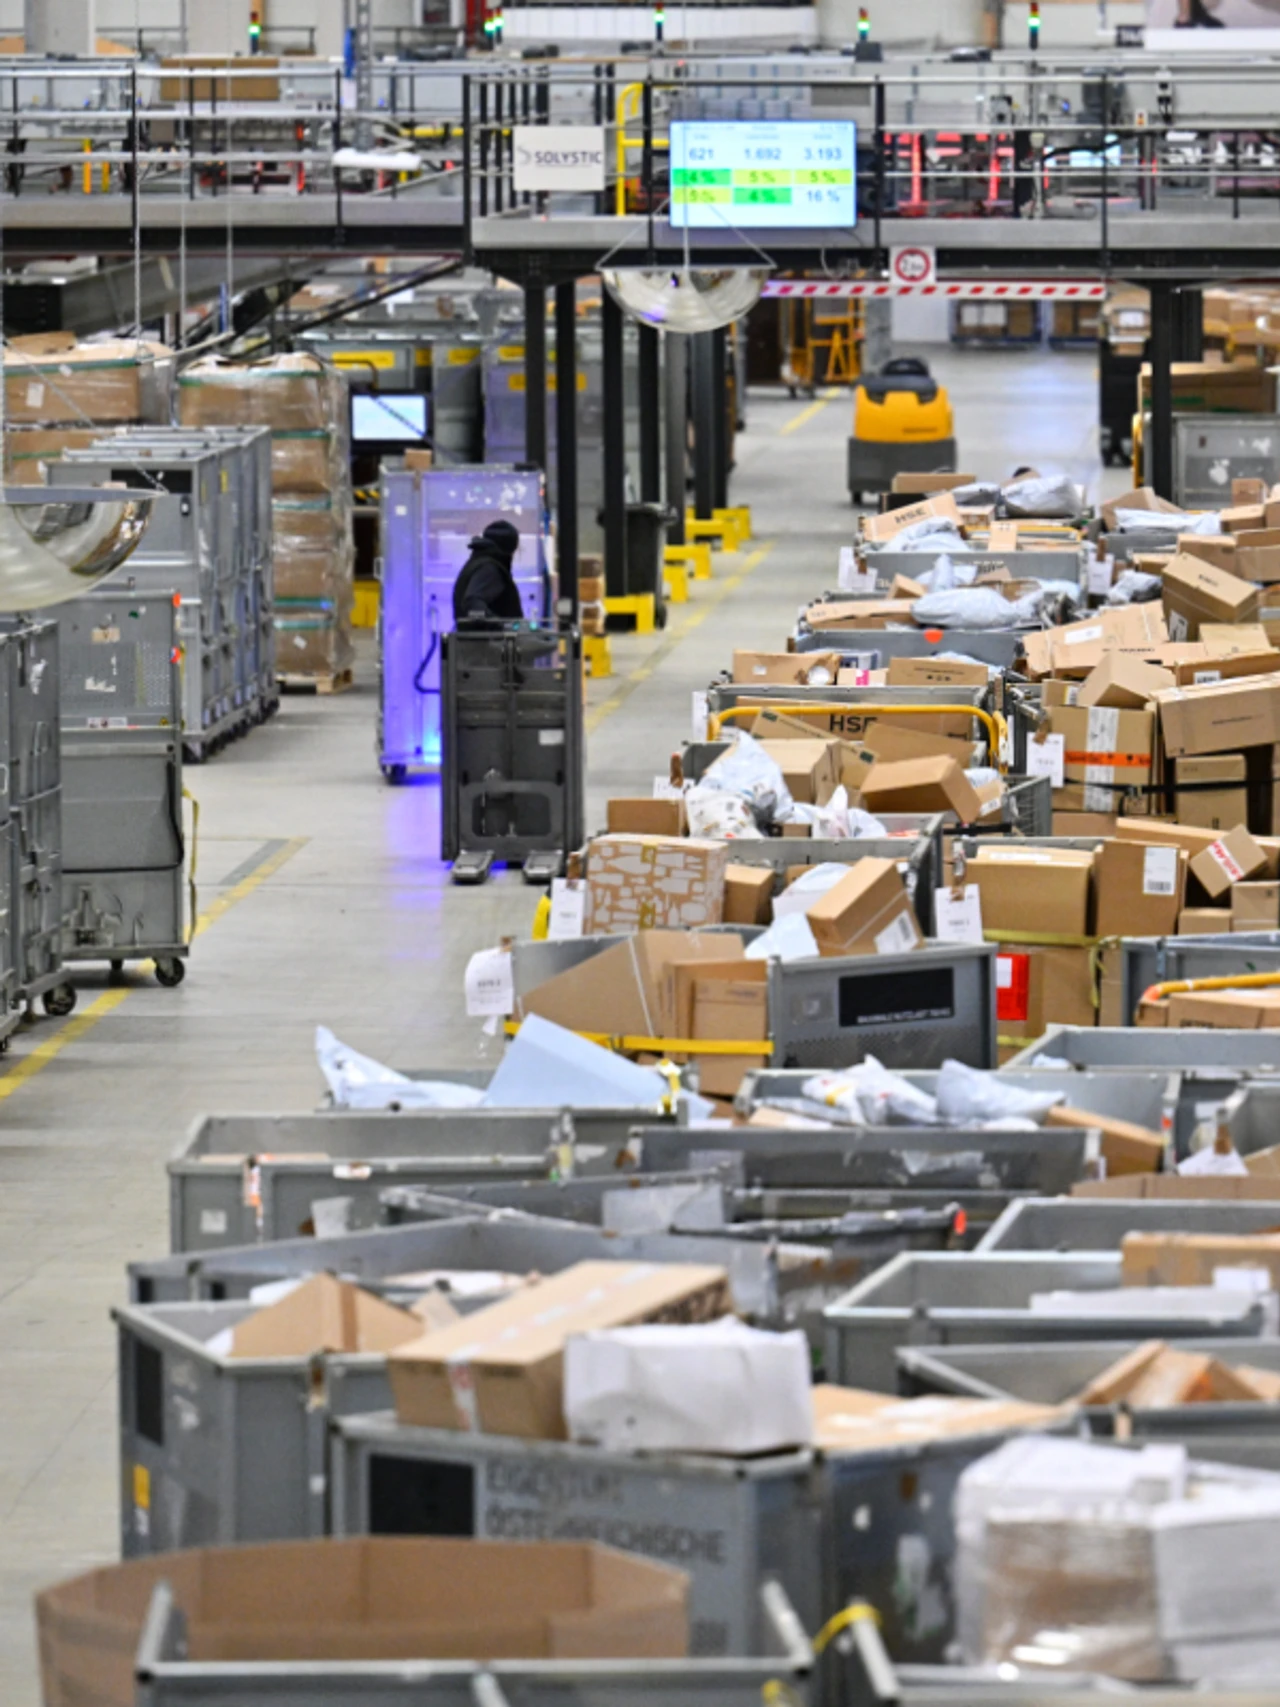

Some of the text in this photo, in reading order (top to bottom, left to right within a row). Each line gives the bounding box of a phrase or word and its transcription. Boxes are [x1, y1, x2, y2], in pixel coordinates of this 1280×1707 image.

[535, 151, 602, 164] SOLYSTIC
[689, 148, 714, 160] 621
[804, 148, 842, 160] 3.193
